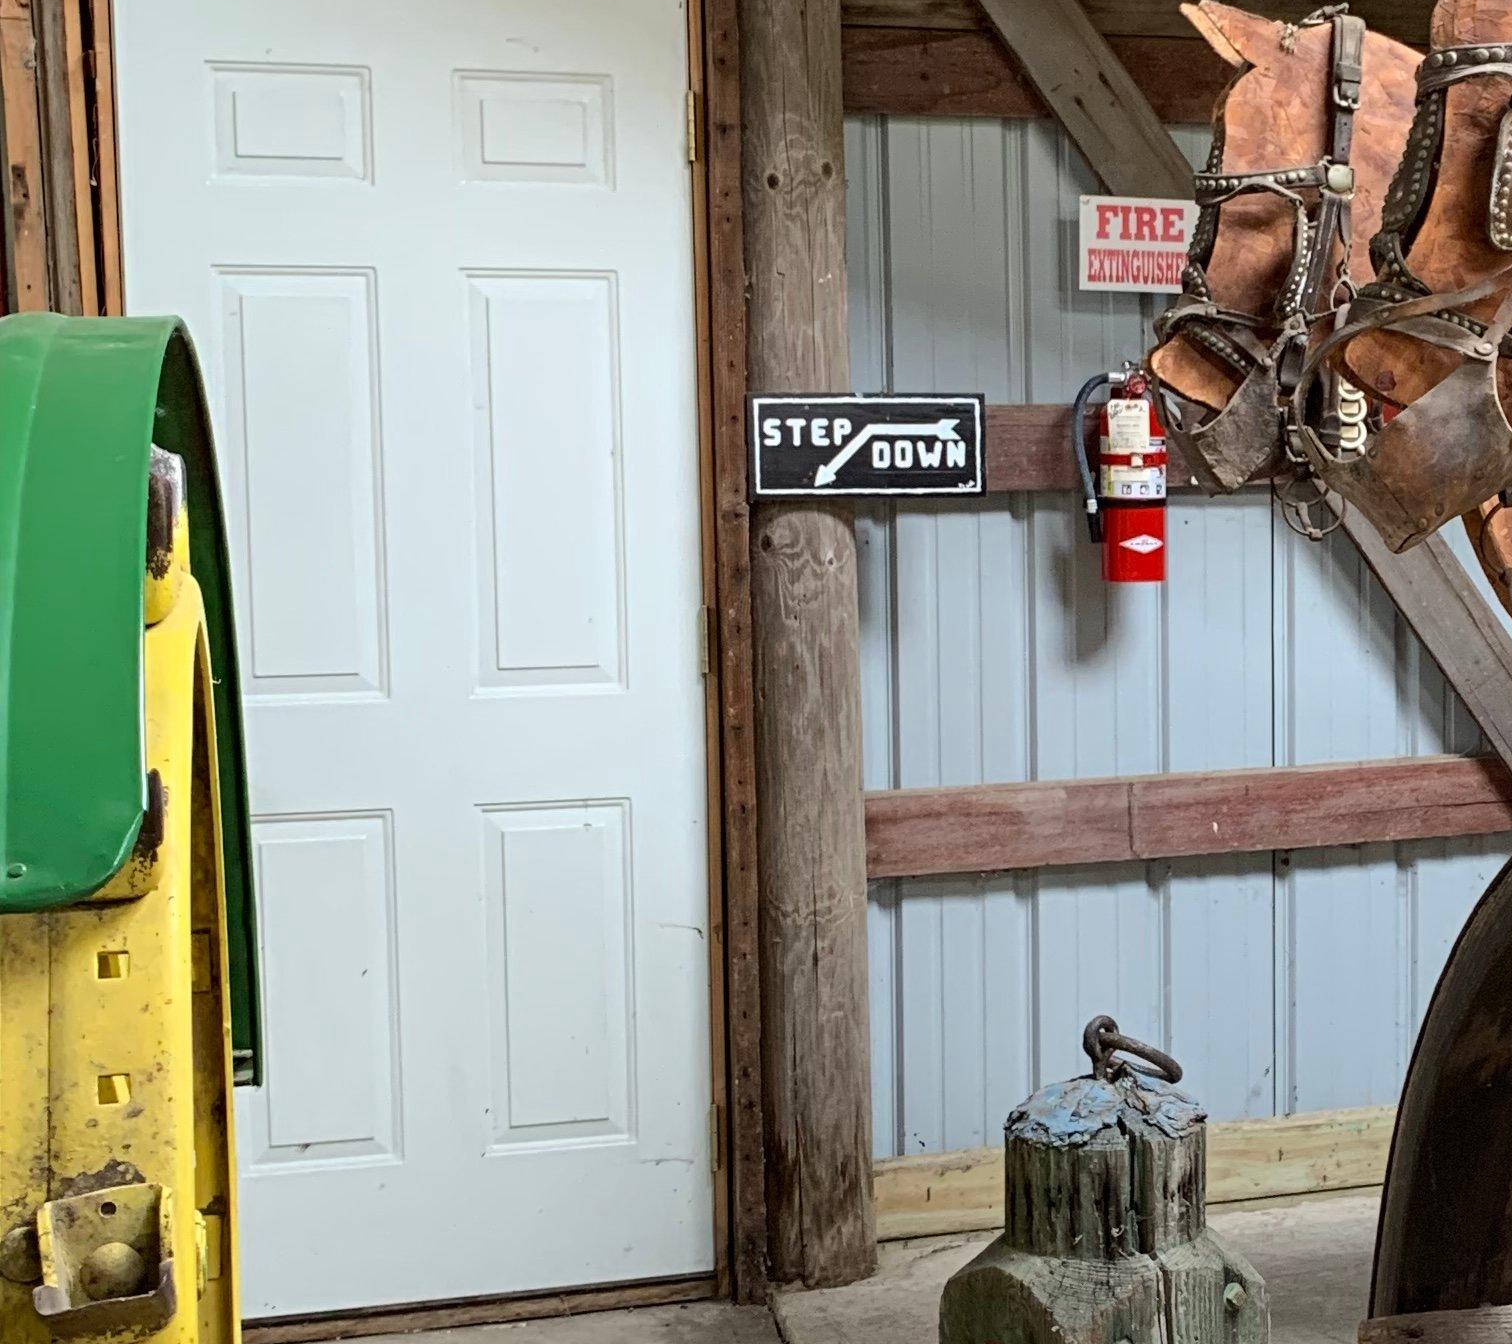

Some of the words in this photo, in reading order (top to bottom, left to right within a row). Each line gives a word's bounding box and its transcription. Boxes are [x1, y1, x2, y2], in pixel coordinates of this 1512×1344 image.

[1096, 204, 1185, 243] FIRE
[1087, 247, 1190, 286] EXTINGUISHE
[762, 417, 853, 447] STEP
[871, 440, 967, 469] DOWN
